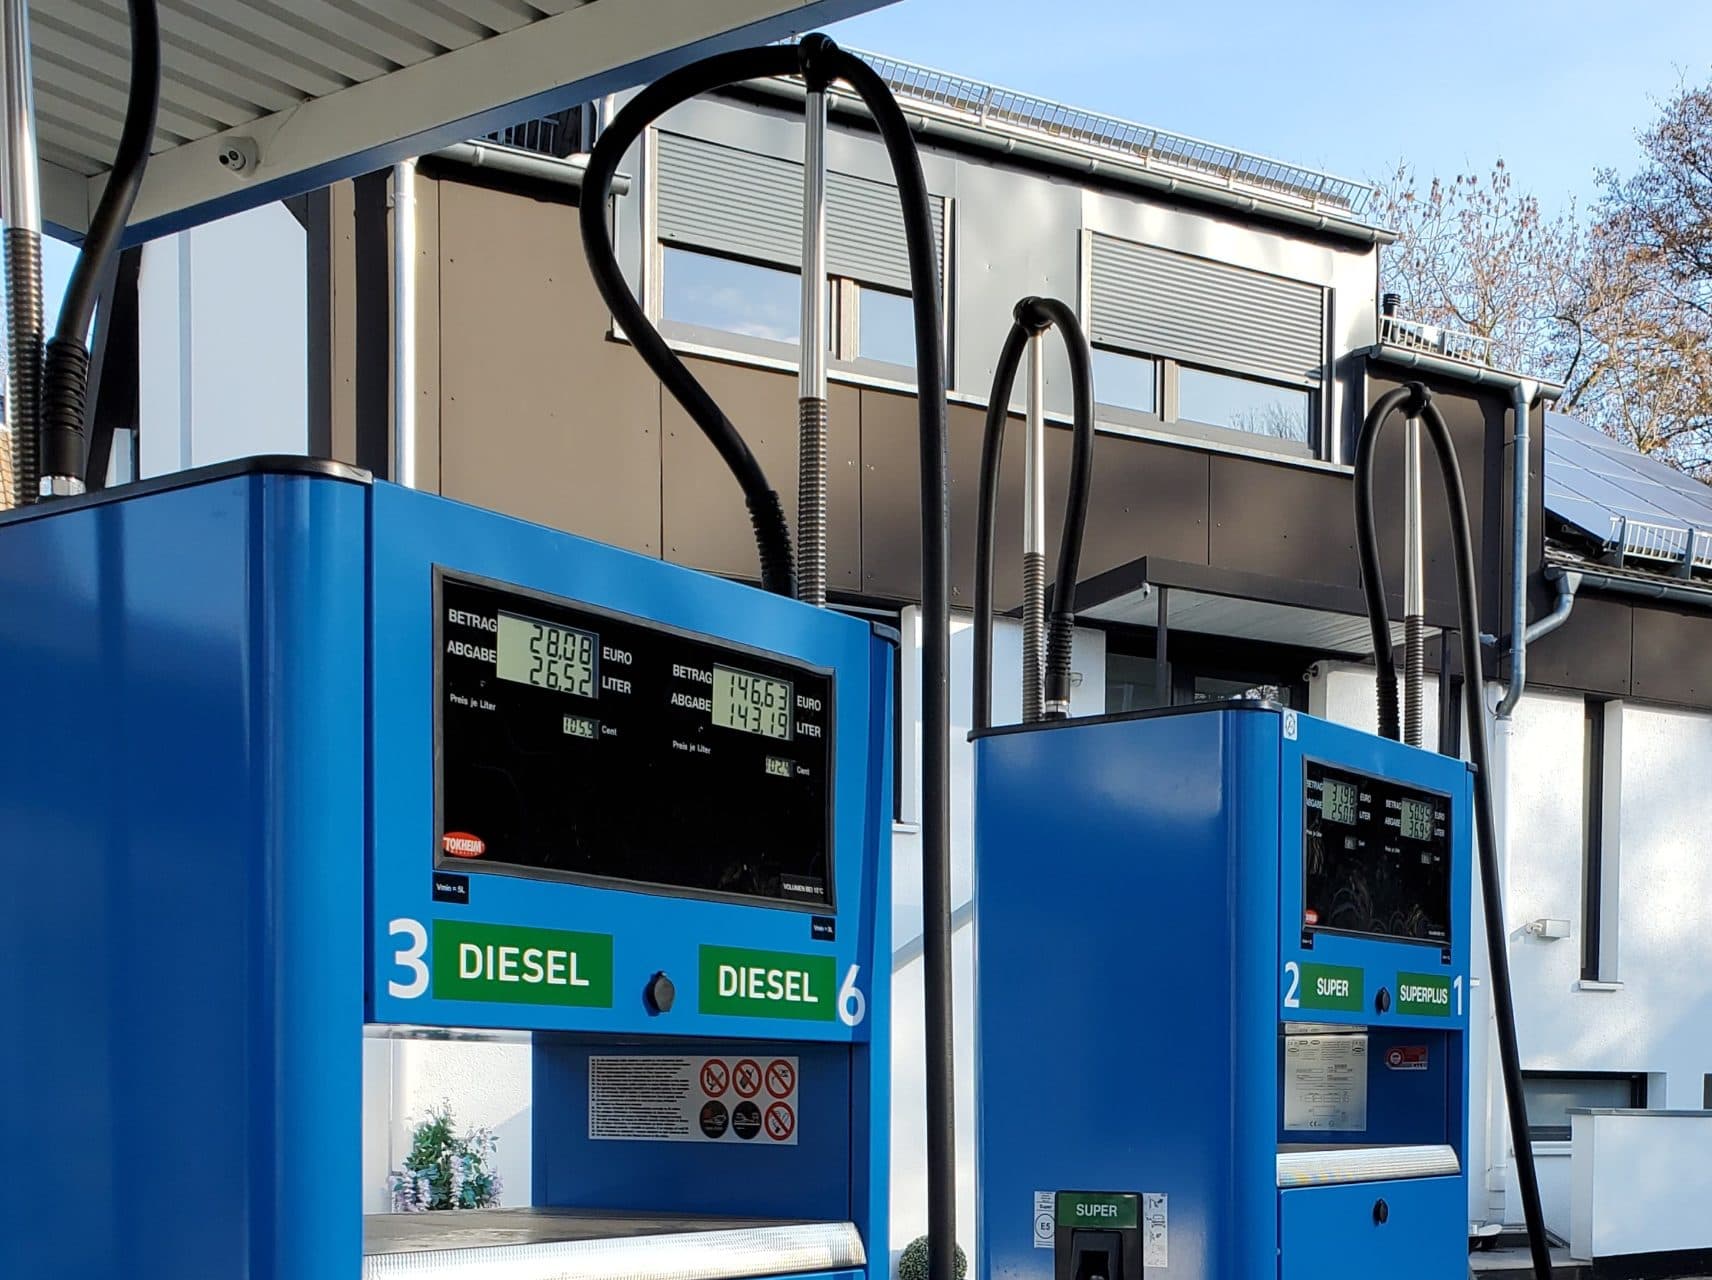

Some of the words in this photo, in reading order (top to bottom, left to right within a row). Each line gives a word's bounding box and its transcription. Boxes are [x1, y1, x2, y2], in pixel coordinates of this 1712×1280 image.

[449, 608, 497, 632] BETRAG
[447, 640, 496, 663] ABGABE
[603, 647, 632, 665] EURO
[673, 664, 712, 684] BETRAG
[602, 676, 631, 694] LITER
[450, 693, 468, 706] Preis
[470, 697, 478, 709] je
[480, 697, 496, 711] Liter
[671, 693, 712, 712] ABGABE
[797, 695, 821, 712] EURO
[602, 725, 617, 736] Cent
[797, 722, 821, 738] LITER
[697, 744, 711, 755] Liter
[1360, 792, 1371, 803] EURO
[443, 836, 482, 853] TOKHEIM
[388, 918, 430, 999] 3
[459, 942, 589, 986] DIESEL
[718, 964, 818, 1003] DIESEL
[1284, 961, 1299, 1008] 2
[1316, 977, 1349, 998] SUPER
[838, 963, 865, 1026] 6
[1400, 985, 1448, 1005] SUPERPLUS
[1454, 975, 1462, 1016] 1
[1076, 1203, 1118, 1217] SUPER
[1040, 1222, 1051, 1231] E5
